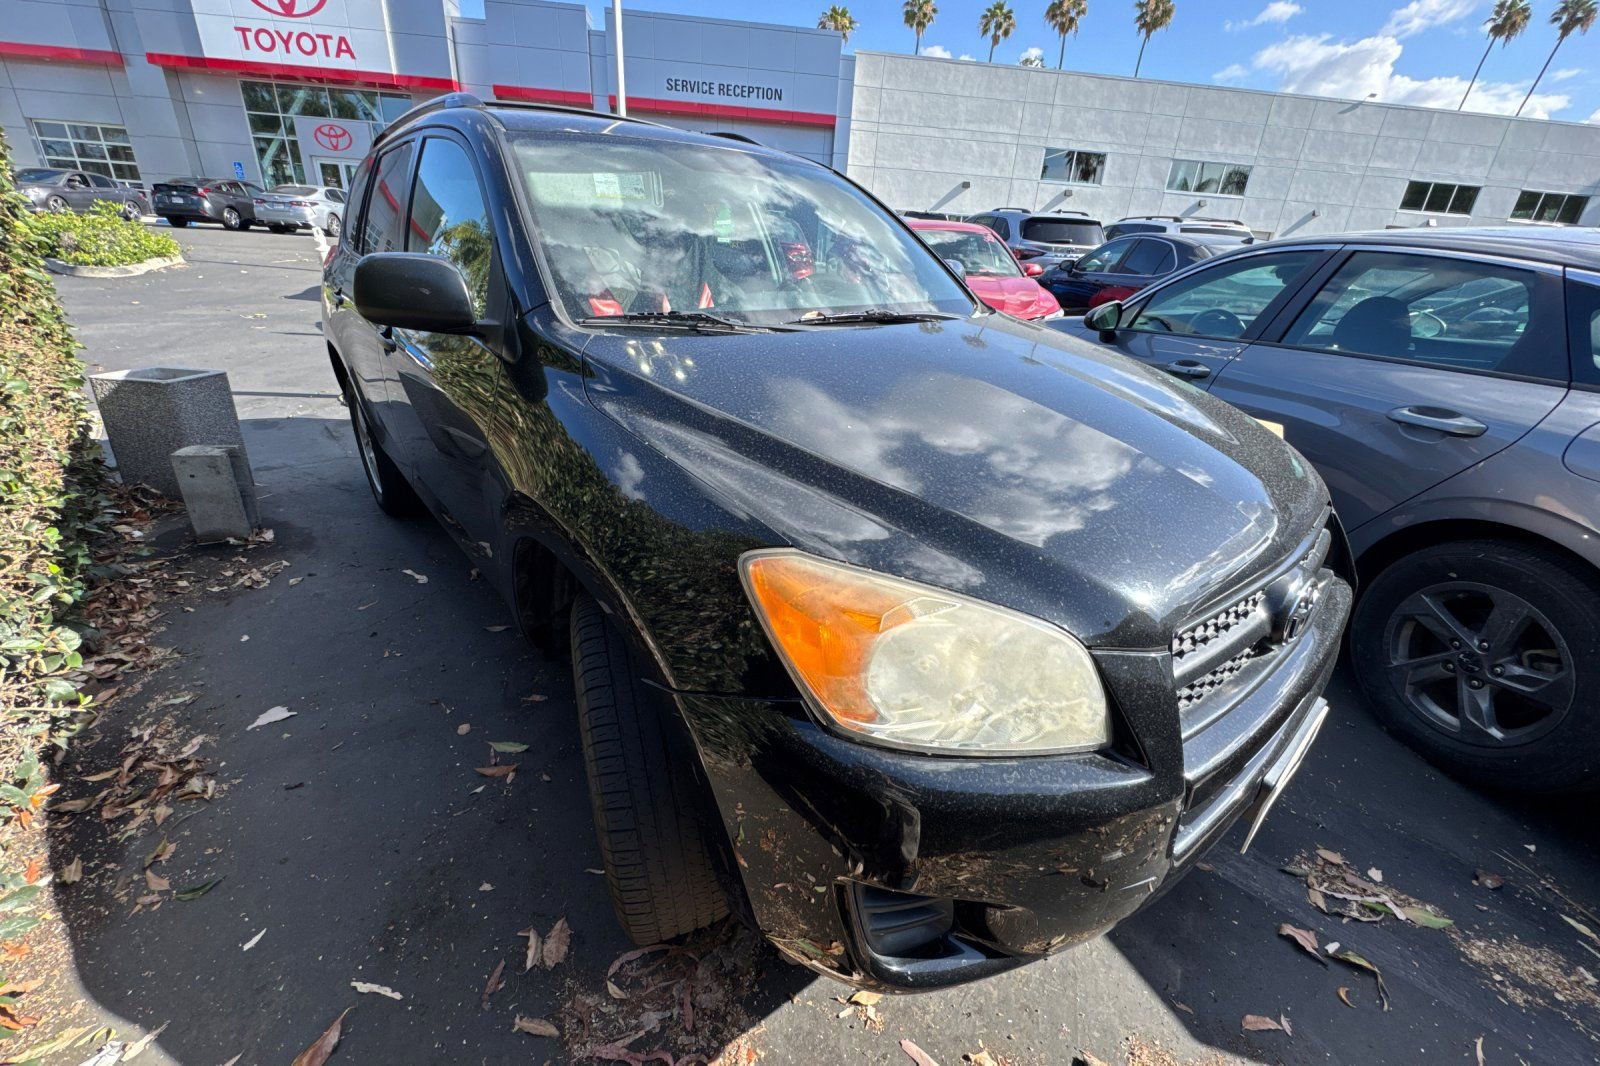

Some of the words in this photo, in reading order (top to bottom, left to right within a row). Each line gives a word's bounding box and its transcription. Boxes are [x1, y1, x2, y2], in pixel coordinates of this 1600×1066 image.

[234, 26, 356, 60] TOYOTA
[666, 78, 715, 95] SERVICE
[718, 83, 783, 101] RECEPTION
